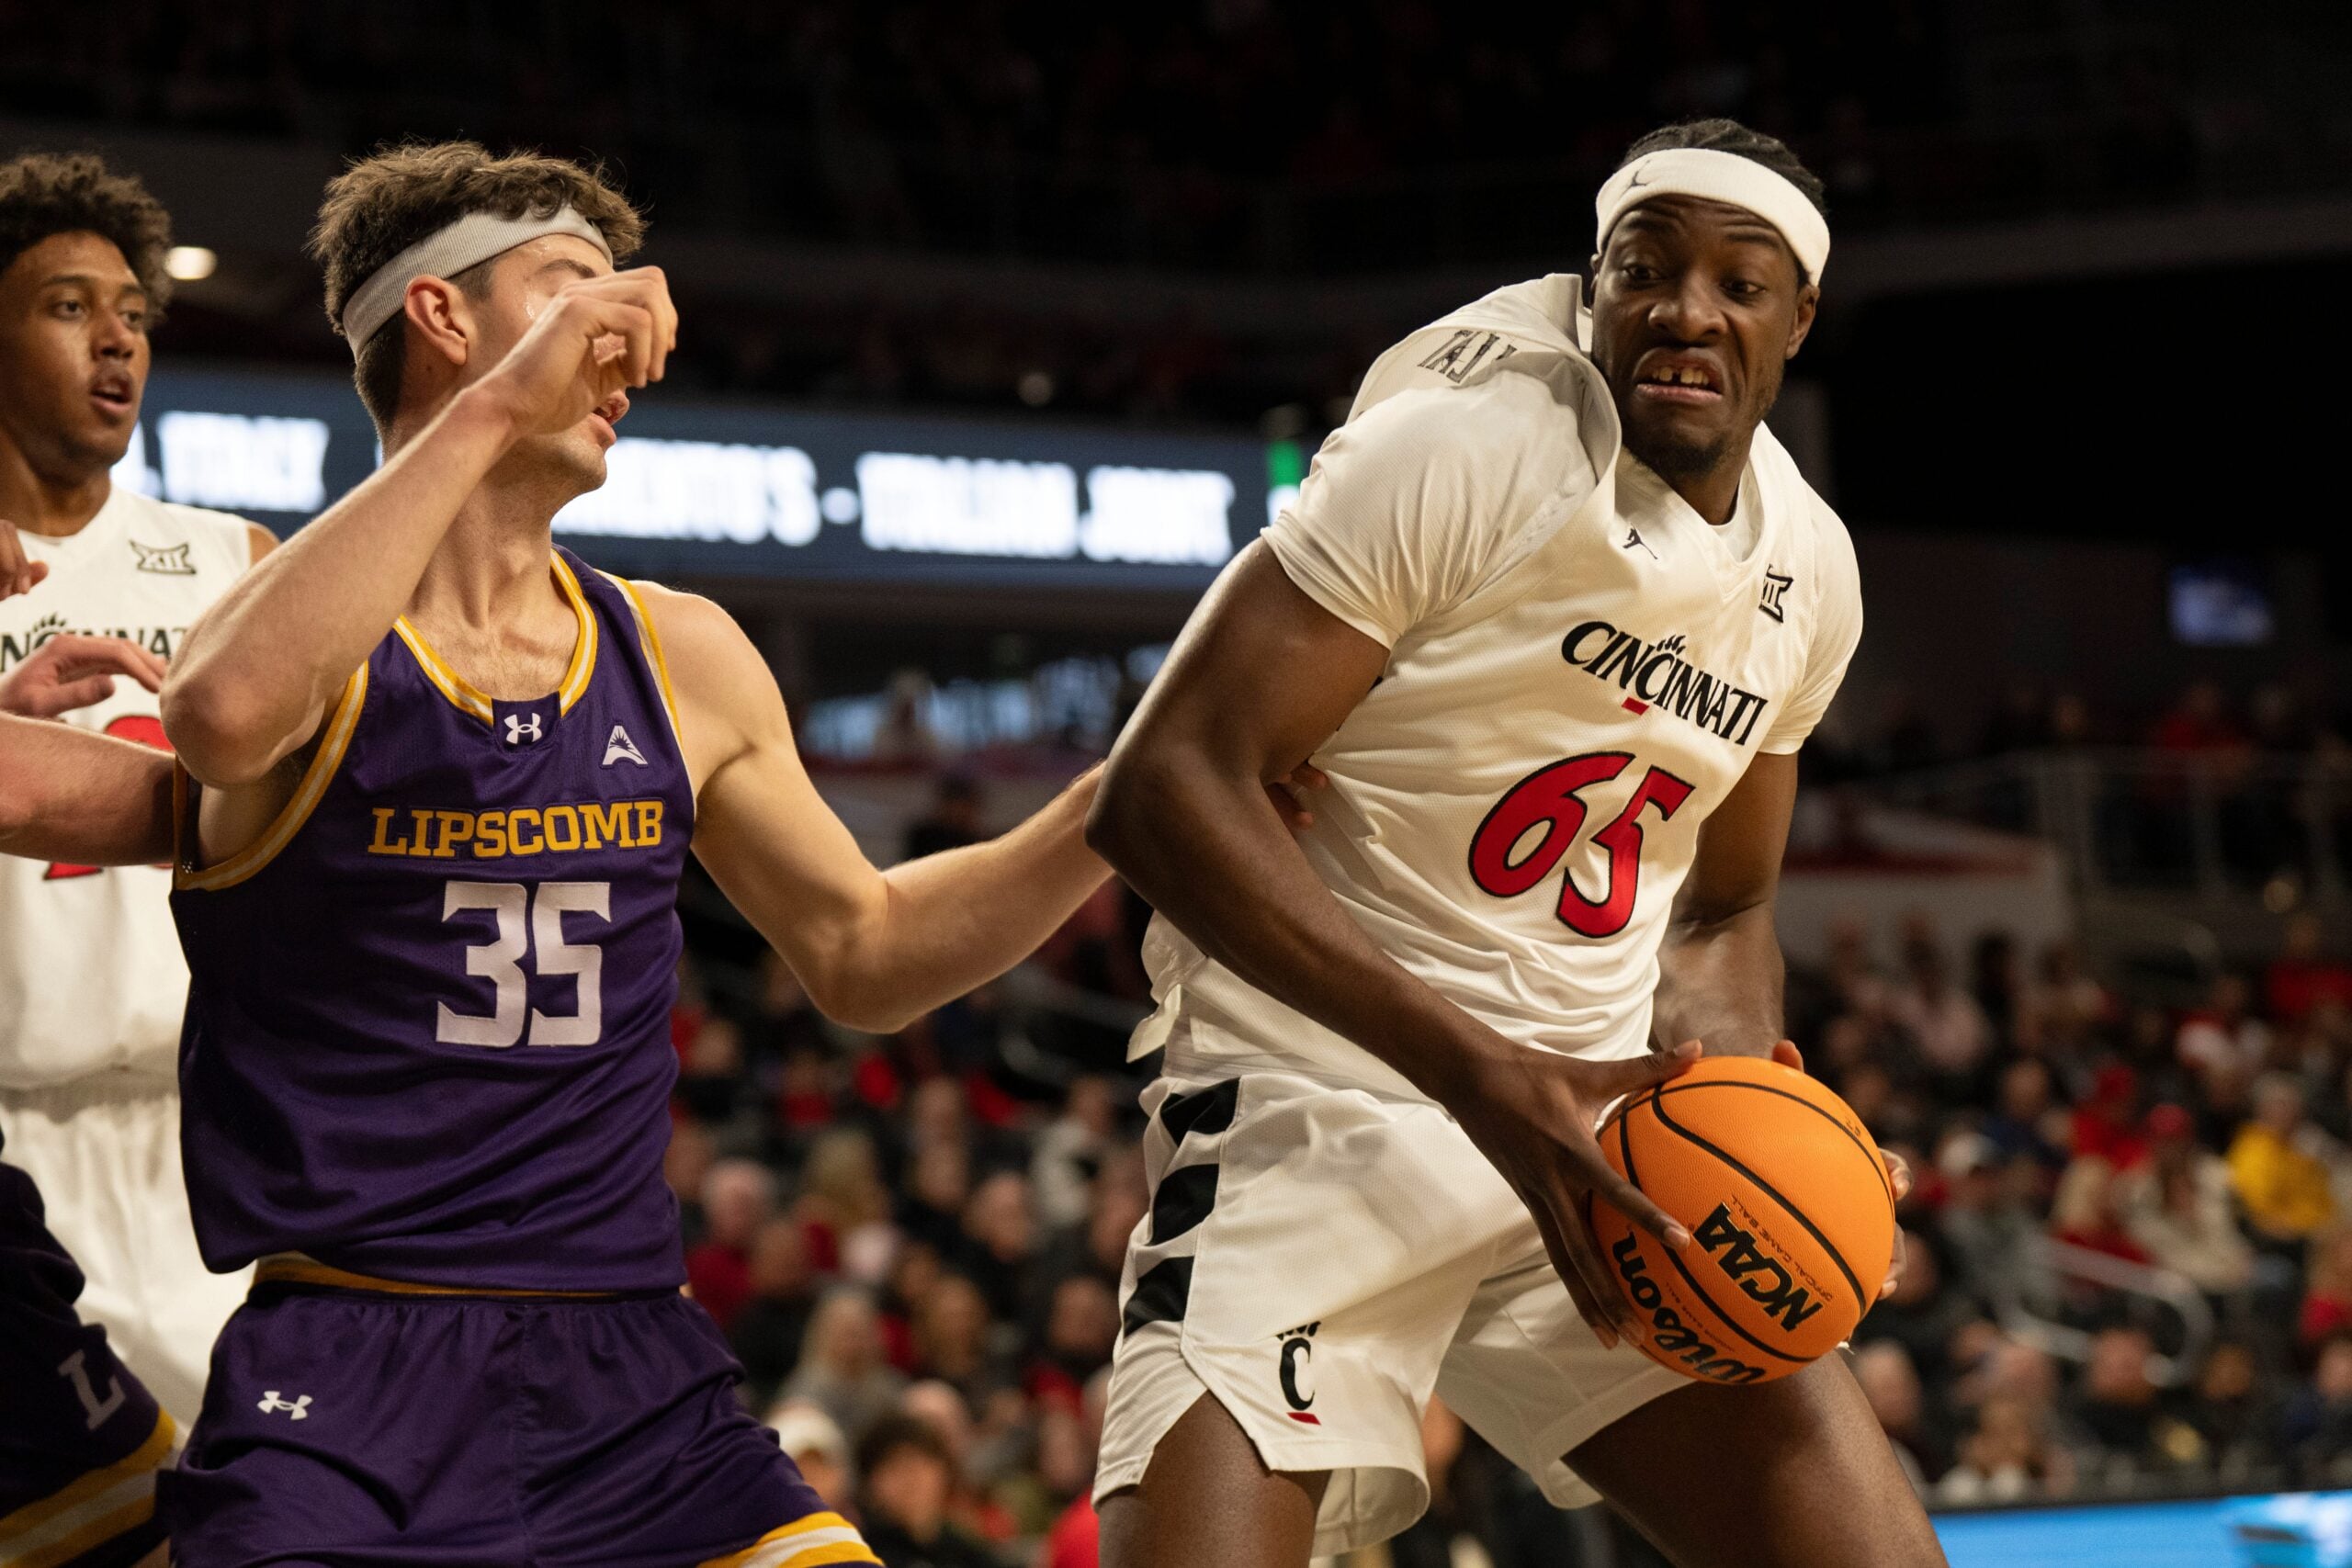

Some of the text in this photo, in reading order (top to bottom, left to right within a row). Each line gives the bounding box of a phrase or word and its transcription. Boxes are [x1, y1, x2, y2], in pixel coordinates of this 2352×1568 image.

[1562, 621, 1768, 746] CINCINNATI
[368, 800, 664, 858] LIPSCOMB
[1468, 750, 1696, 939] 65
[435, 880, 612, 1047] 35
[1612, 1231, 1766, 1384] Wilson
[1692, 1201, 1824, 1333] NCAA
[1731, 1194, 1834, 1302] OFFICIAL GAME BALL
[58, 1348, 126, 1429] L
